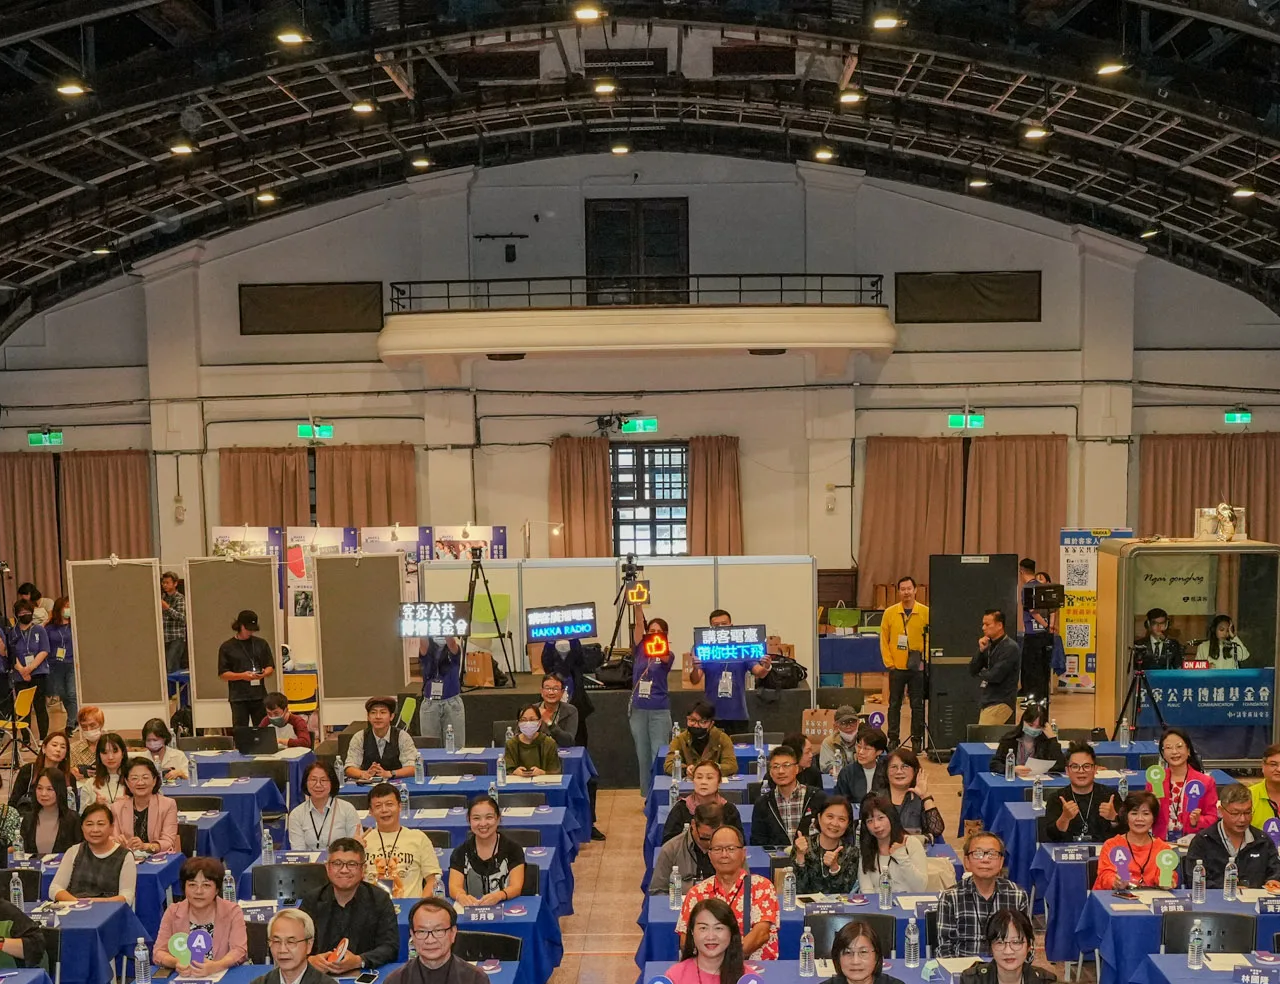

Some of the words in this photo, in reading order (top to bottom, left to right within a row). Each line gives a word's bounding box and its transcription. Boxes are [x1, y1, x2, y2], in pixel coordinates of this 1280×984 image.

[402, 603, 455, 619] 客家公共
[531, 626, 562, 638] HAKKA
[564, 623, 592, 635] RADIO
[1184, 661, 1194, 669] ON
[1195, 661, 1207, 669] AIR
[1150, 768, 1161, 780] C
[1188, 783, 1201, 795] A
[1267, 821, 1279, 832] A
[1114, 849, 1127, 862] A
[1161, 853, 1173, 865] C
[173, 936, 187, 951] C
[191, 935, 207, 950] A
